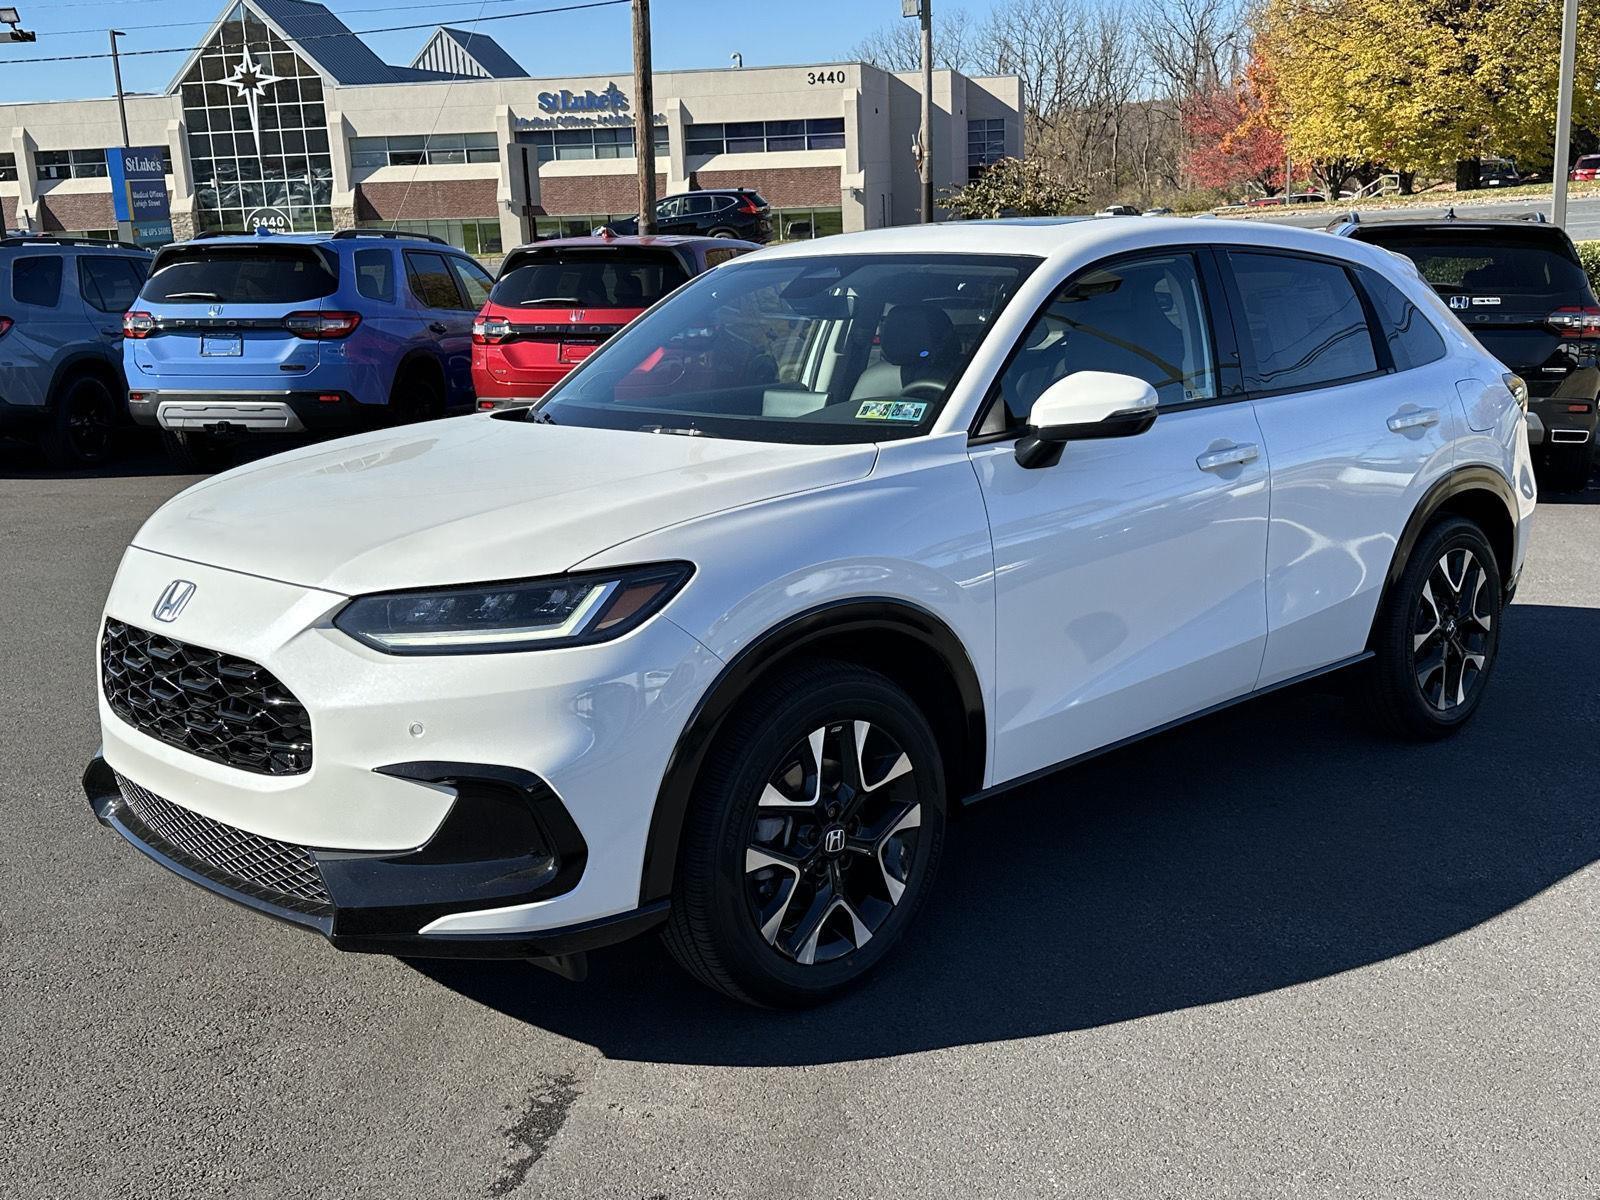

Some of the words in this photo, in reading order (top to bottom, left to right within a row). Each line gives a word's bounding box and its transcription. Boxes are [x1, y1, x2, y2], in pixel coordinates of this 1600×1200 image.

[807, 70, 846, 85] 3440
[252, 216, 285, 228] 3440
[175, 319, 257, 327] PILOT
